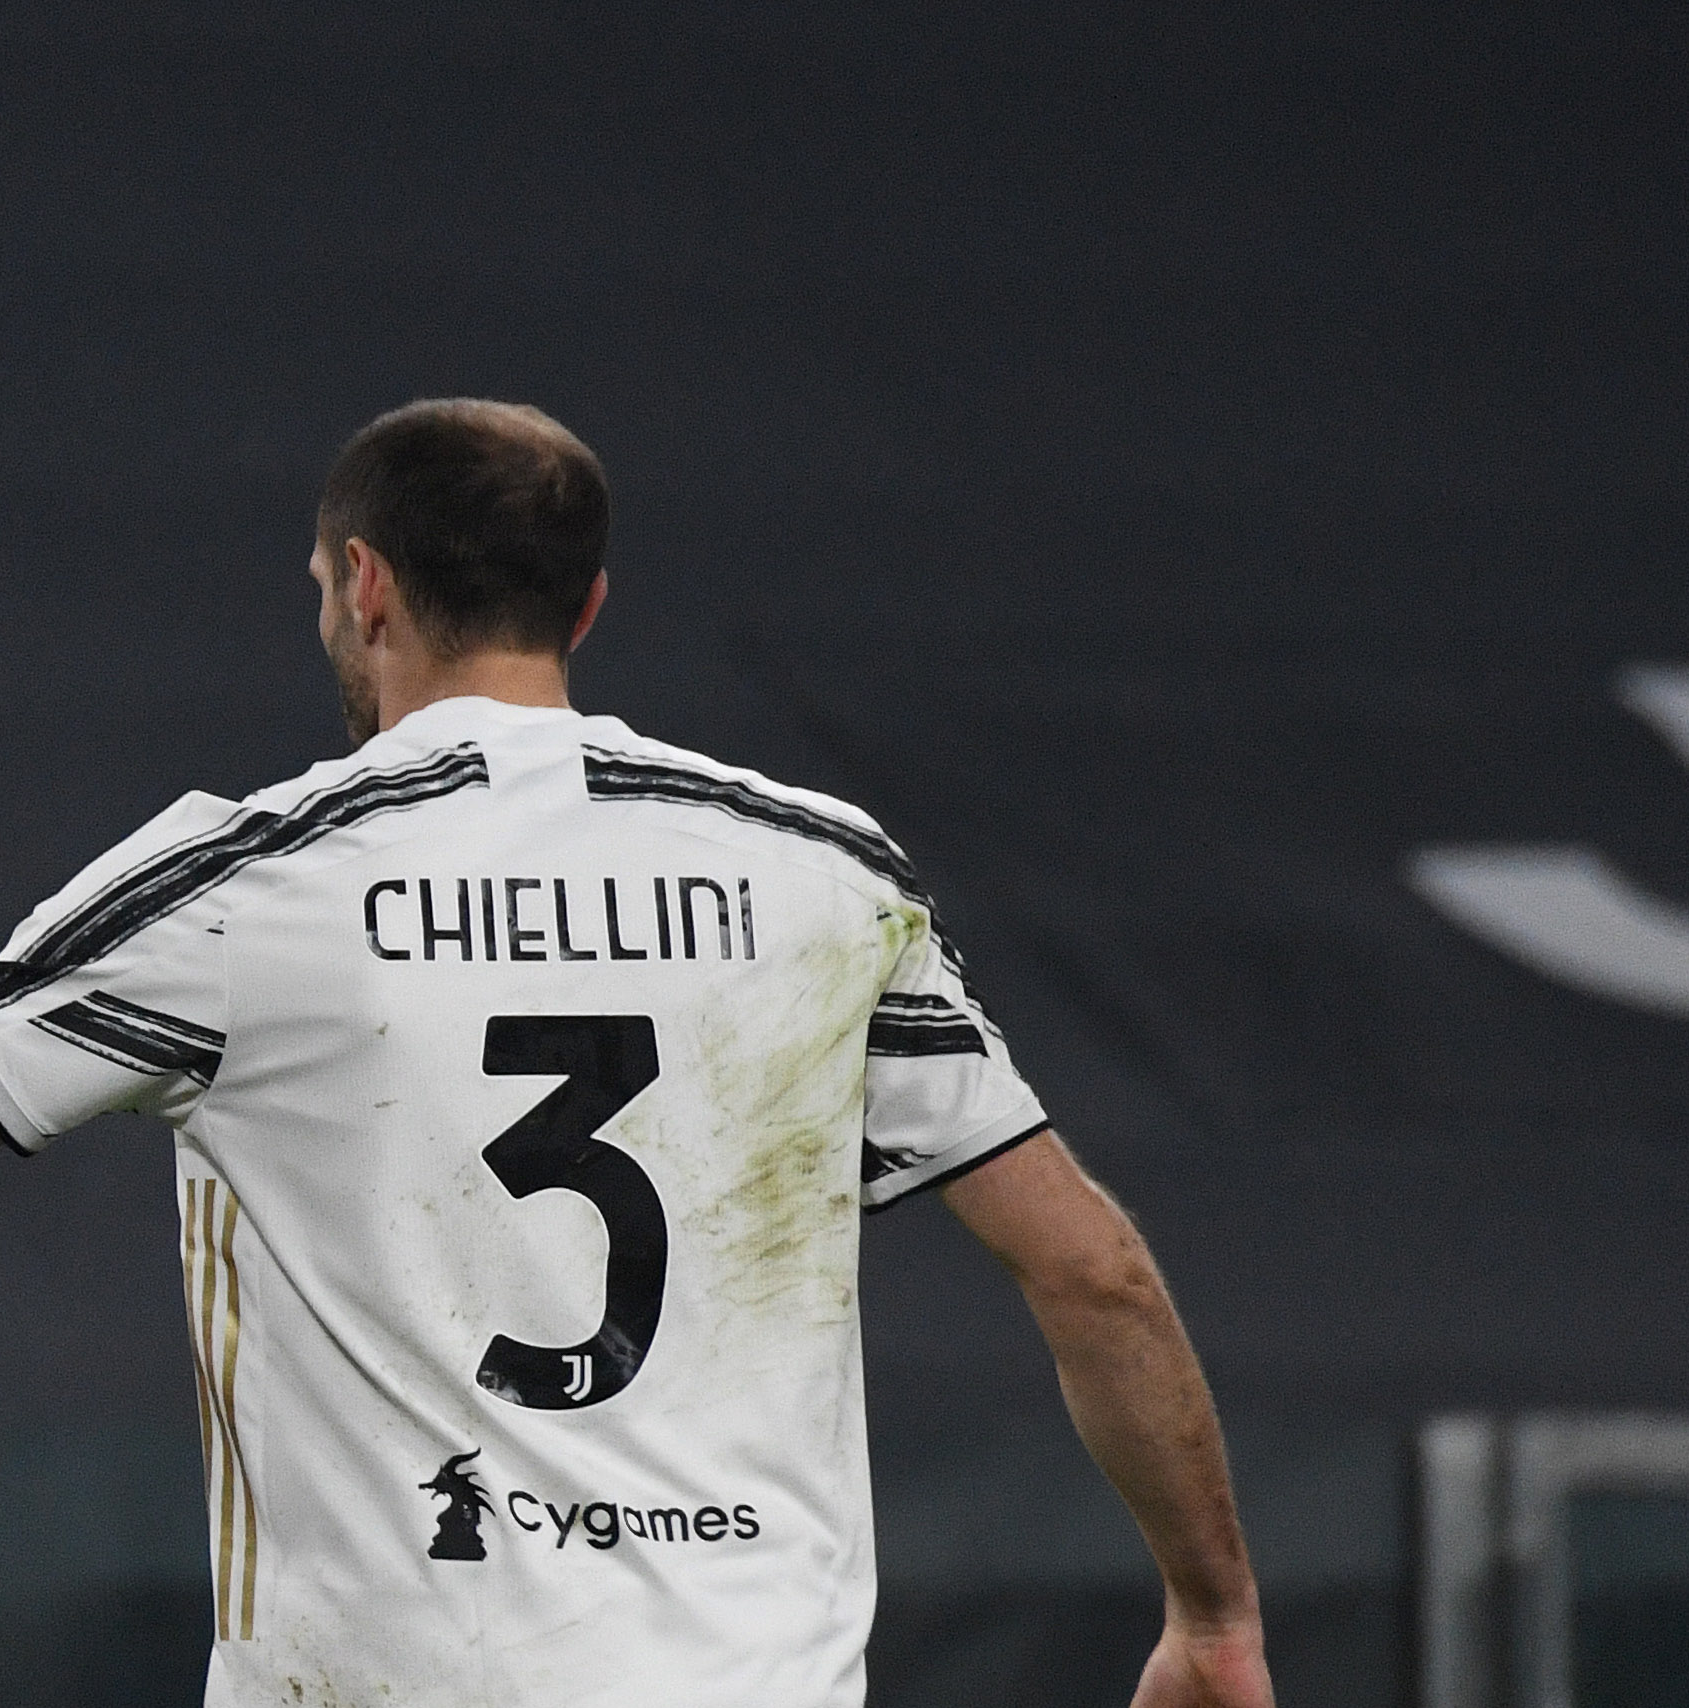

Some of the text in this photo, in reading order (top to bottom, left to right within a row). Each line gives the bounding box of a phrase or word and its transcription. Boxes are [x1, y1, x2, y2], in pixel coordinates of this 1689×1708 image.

[362, 877, 757, 962] CHIELLINI
[475, 1014, 669, 1411] 3
[506, 1488, 761, 1550] Cygames
